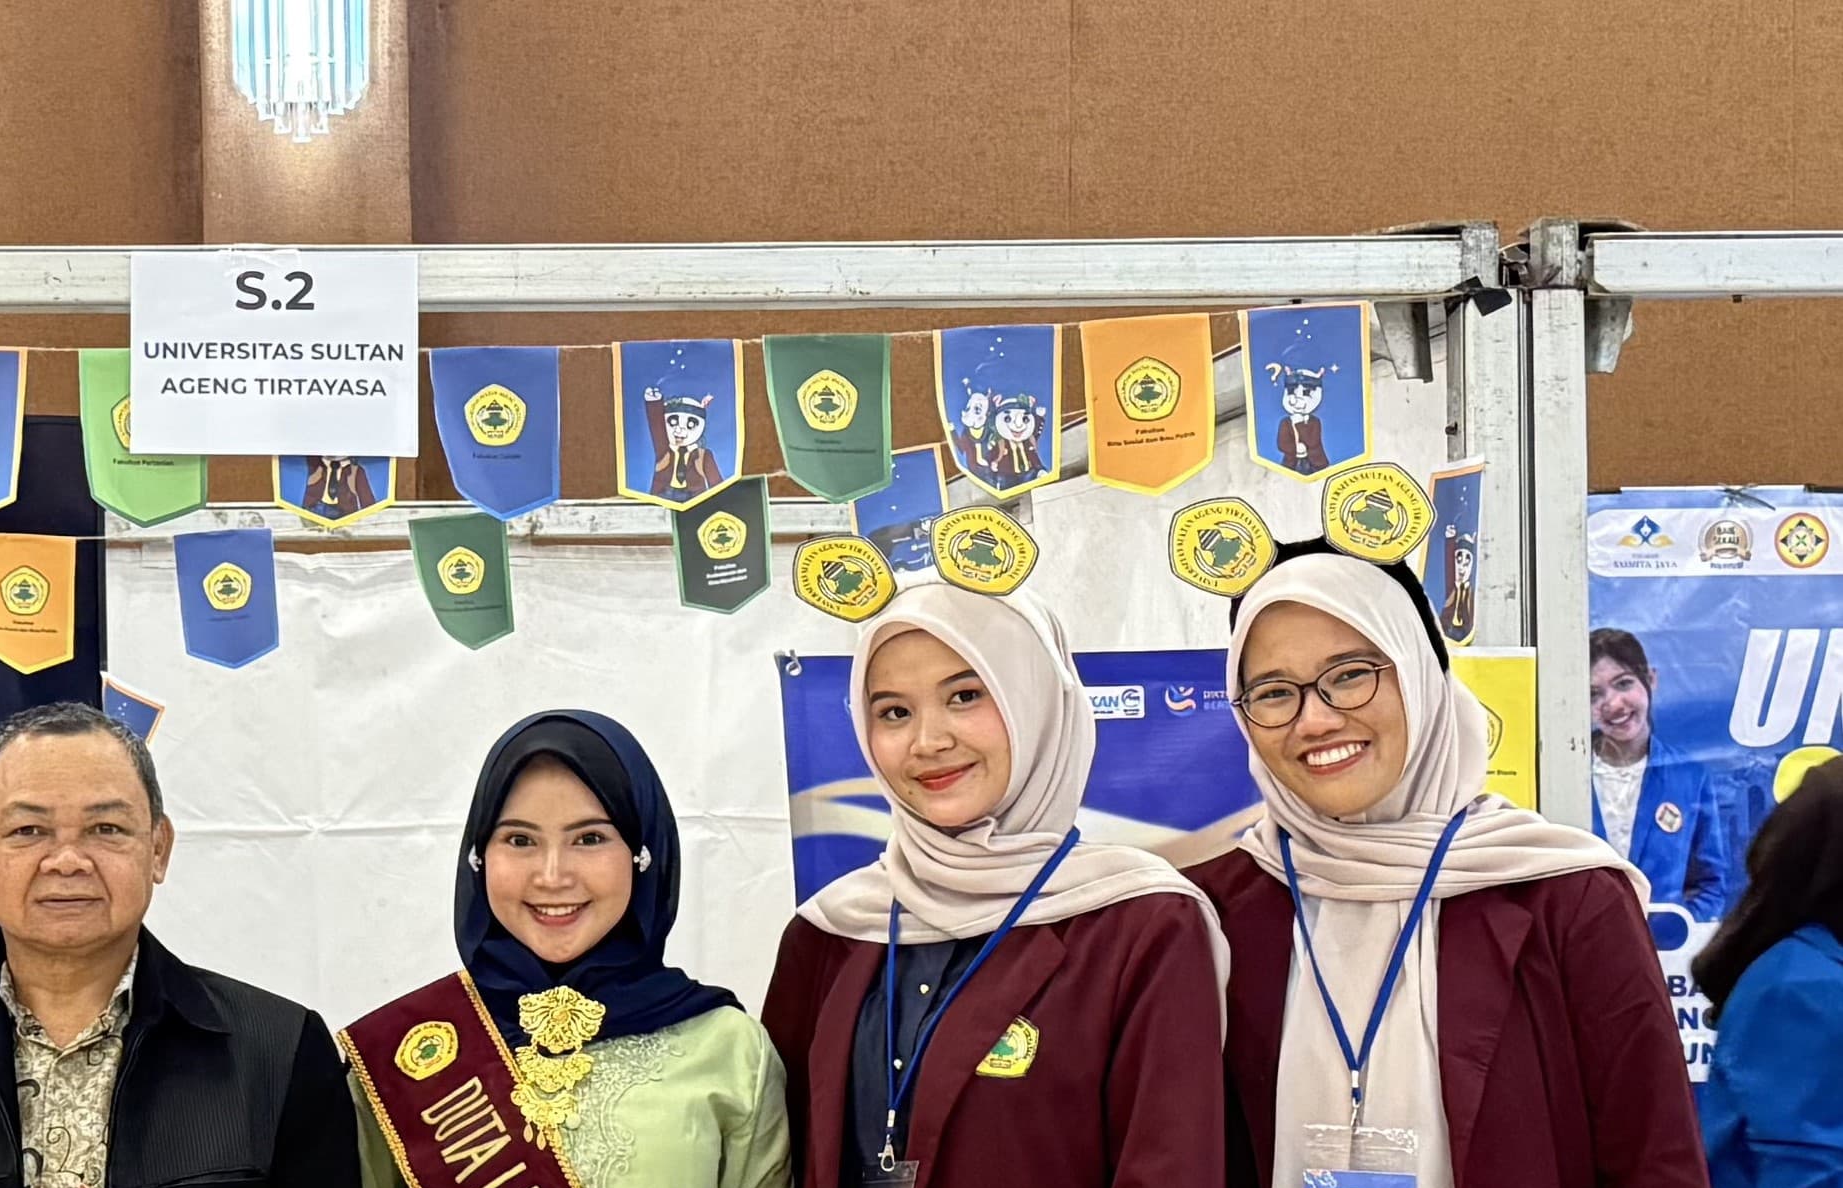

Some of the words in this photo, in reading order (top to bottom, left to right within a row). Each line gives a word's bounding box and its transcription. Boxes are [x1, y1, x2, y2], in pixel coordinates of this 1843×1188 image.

[235, 271, 315, 310] S.2
[143, 342, 304, 360] UNIVERSITAS
[310, 343, 404, 361] SULTAN
[160, 378, 248, 395] AGENG
[254, 378, 388, 397] TIRTAYASA
[420, 1076, 512, 1184] DUTA
